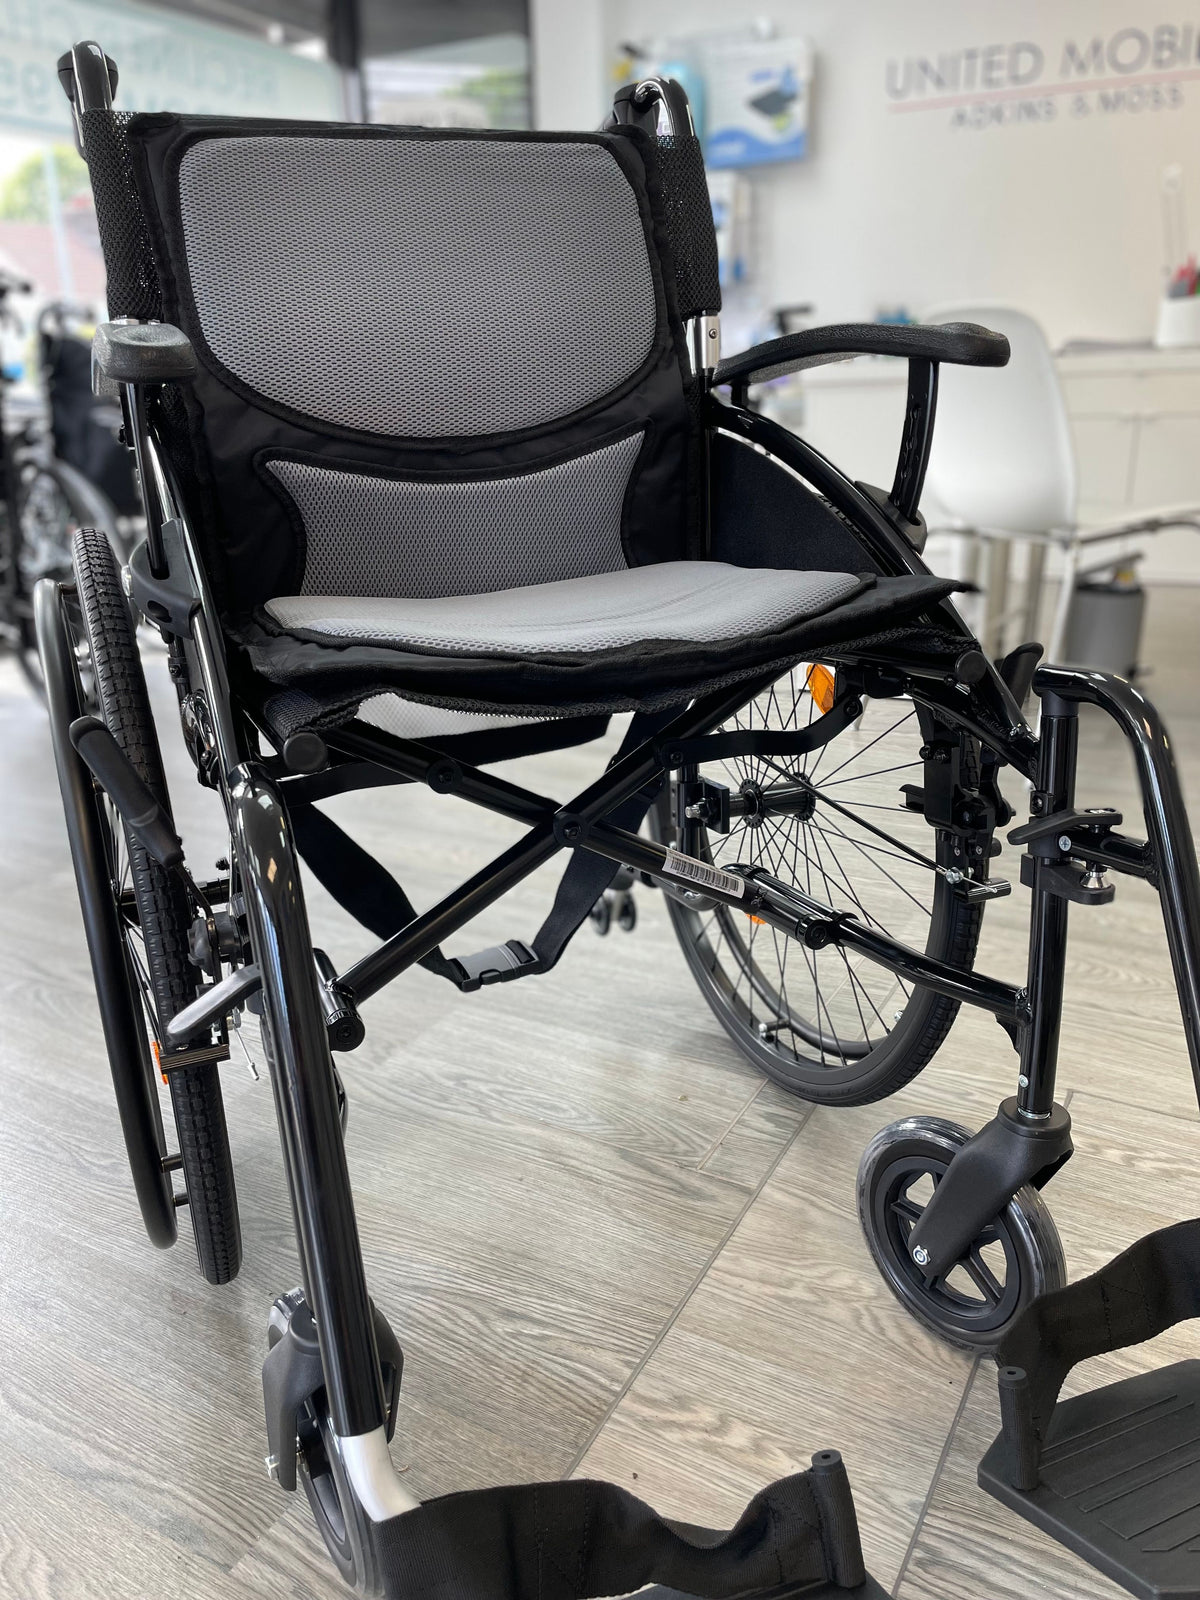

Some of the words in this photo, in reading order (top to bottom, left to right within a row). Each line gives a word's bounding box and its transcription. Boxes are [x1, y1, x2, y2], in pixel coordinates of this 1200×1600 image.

[885, 40, 1045, 99] UNITED
[1060, 23, 1200, 77] MOBI
[1098, 82, 1184, 113] MOSS
